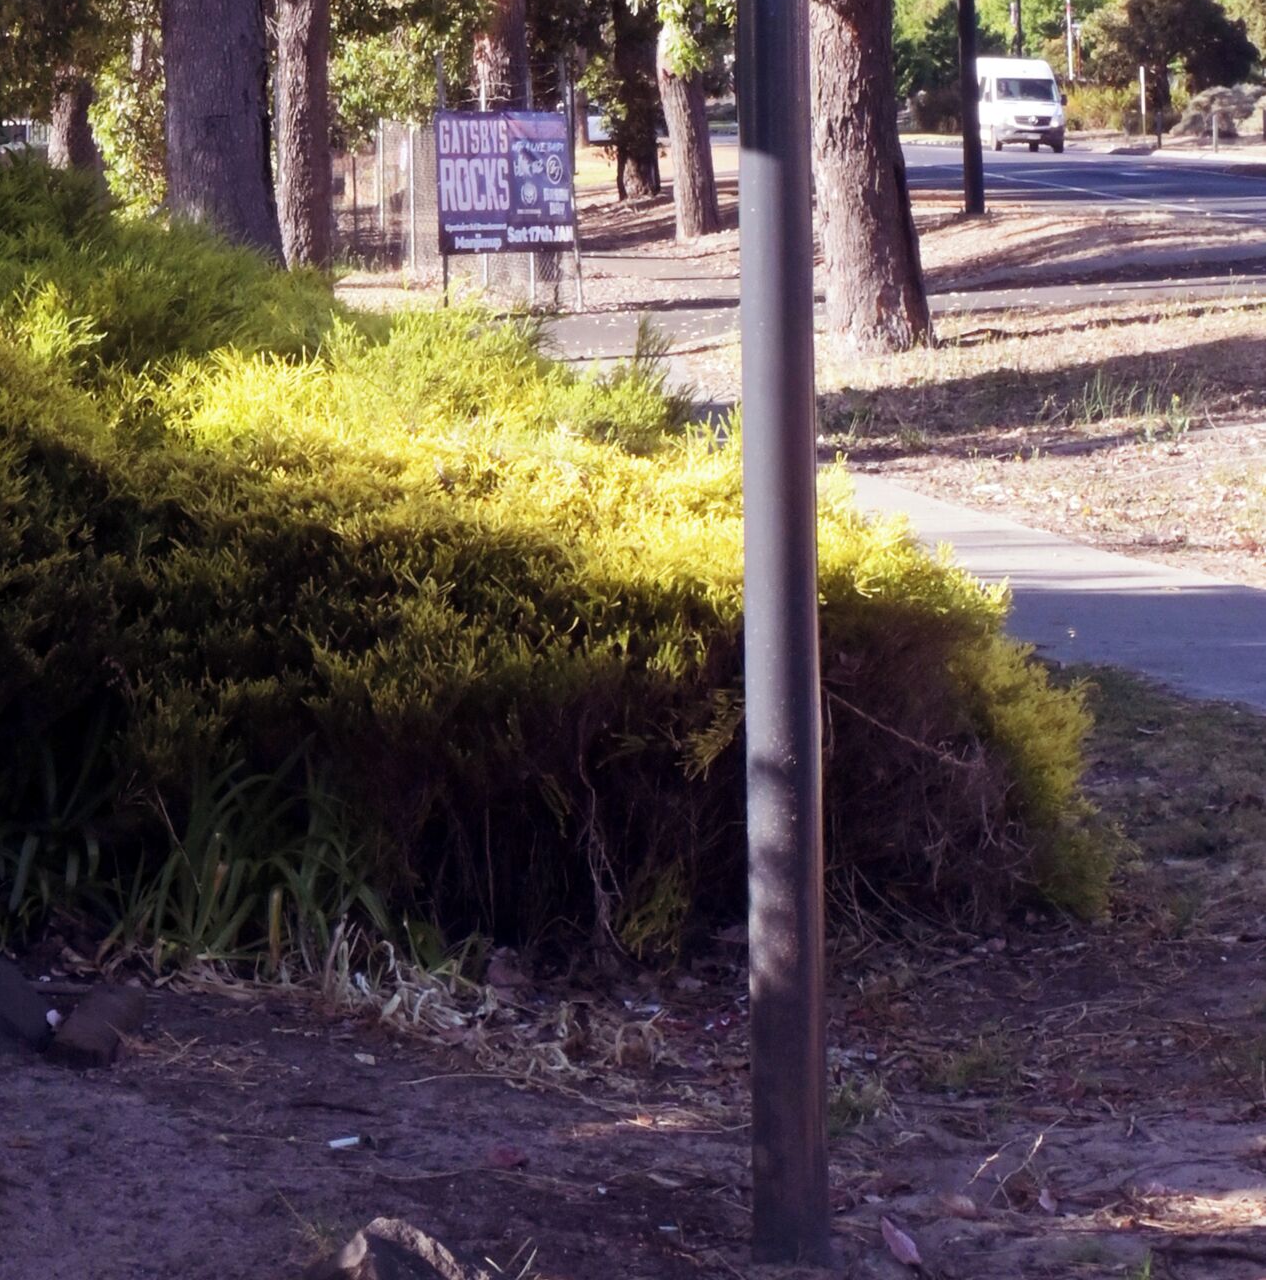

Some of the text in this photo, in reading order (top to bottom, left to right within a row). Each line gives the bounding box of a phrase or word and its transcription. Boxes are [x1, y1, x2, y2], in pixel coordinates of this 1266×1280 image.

[439, 119, 509, 155] GATSBYS
[440, 157, 511, 212] ROCKS
[507, 225, 528, 243] Sat
